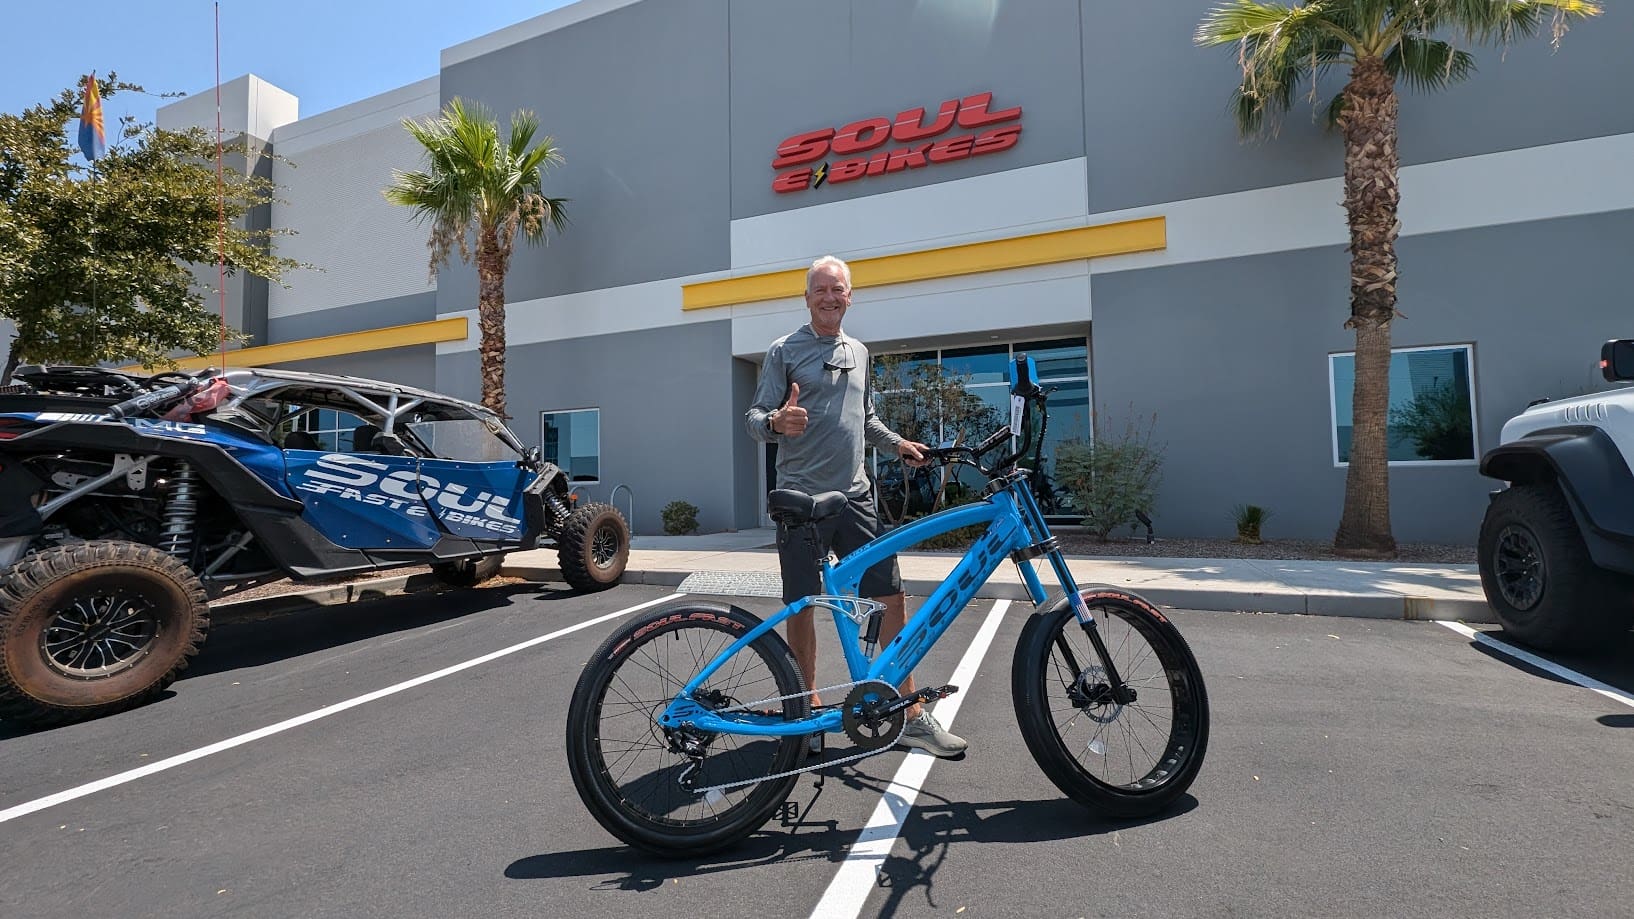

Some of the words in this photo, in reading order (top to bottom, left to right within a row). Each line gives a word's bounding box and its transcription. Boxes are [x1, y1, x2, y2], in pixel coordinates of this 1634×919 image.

[771, 91, 1022, 170] SOUL
[296, 480, 410, 510] FAST
[443, 511, 518, 535] BIKES
[303, 453, 522, 525] SOUL
[897, 525, 1018, 669] SOUL
